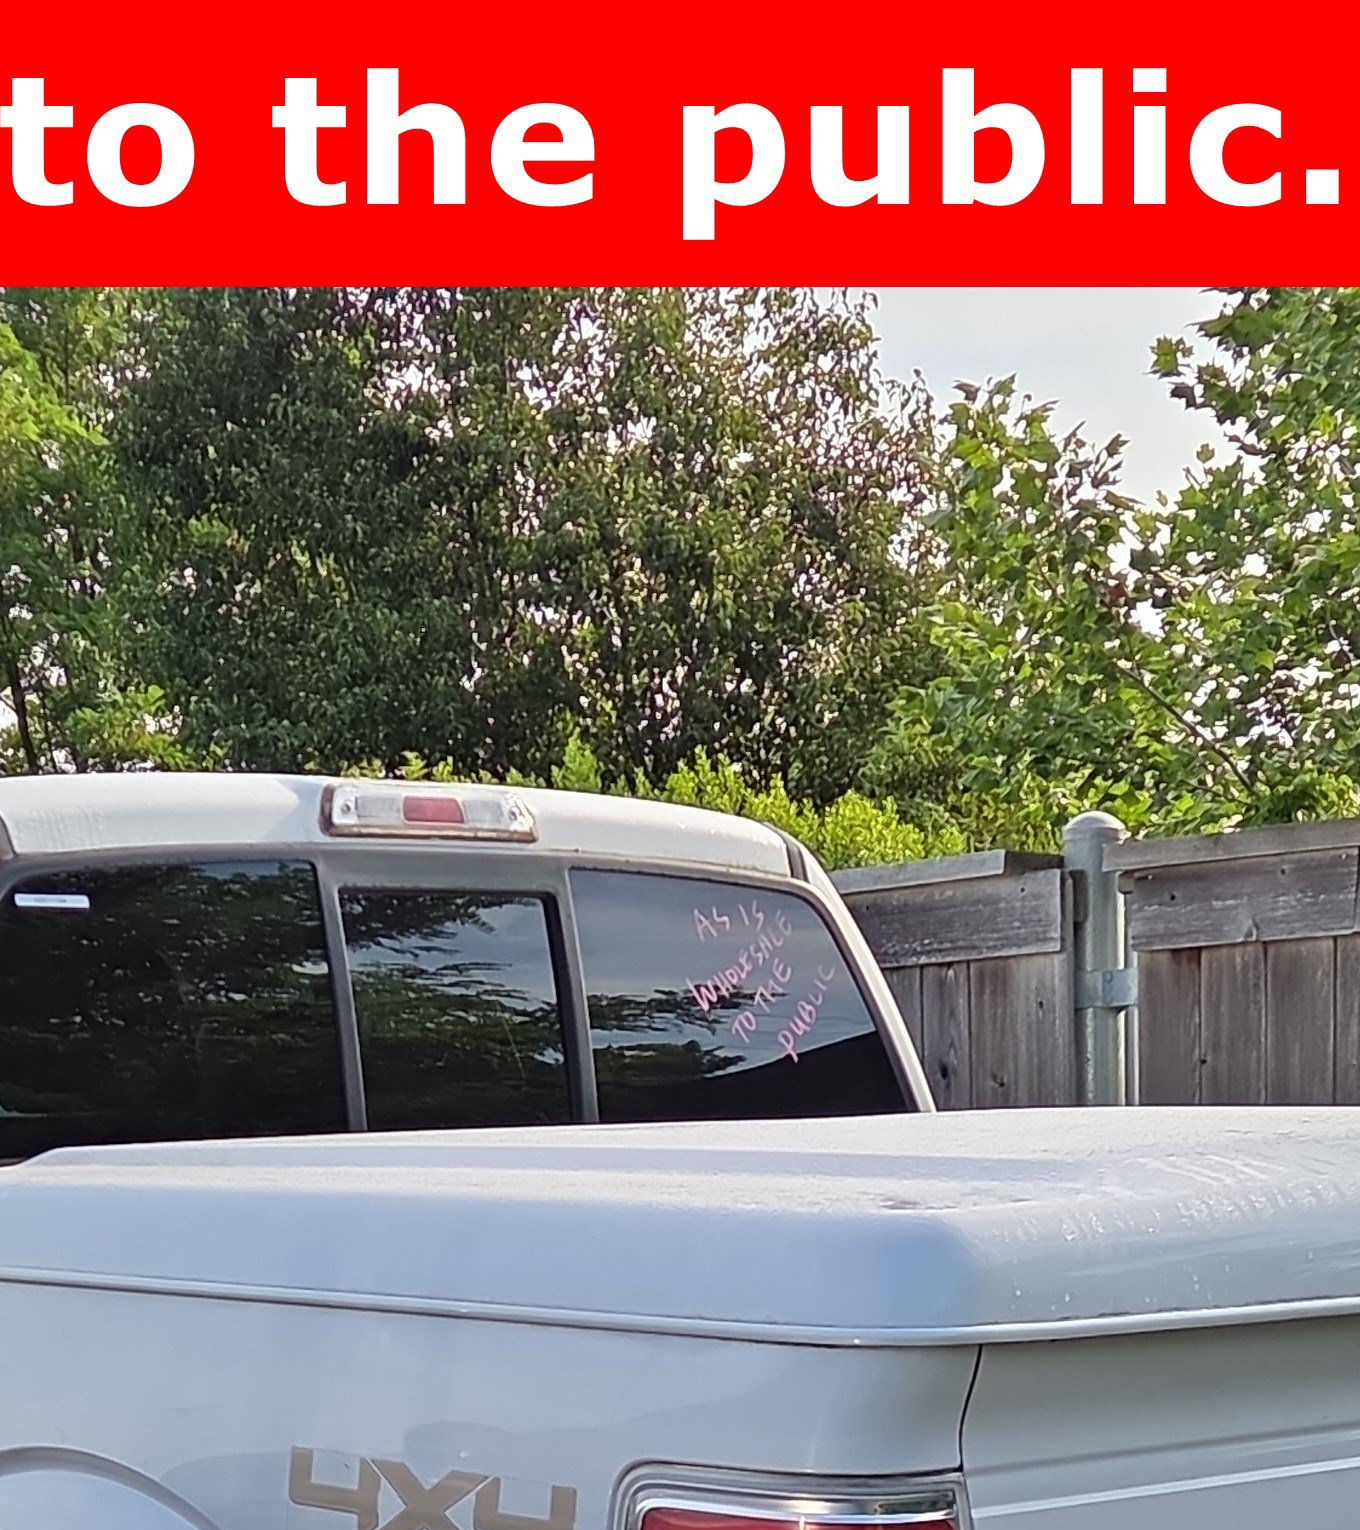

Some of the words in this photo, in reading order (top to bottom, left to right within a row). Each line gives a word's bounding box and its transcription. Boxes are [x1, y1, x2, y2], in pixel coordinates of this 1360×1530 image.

[693, 906, 731, 941] AS
[738, 900, 765, 932] IS
[685, 909, 793, 1013] WHOLESALE
[731, 1010, 757, 1044] TO
[777, 964, 836, 1064] PUBLIC
